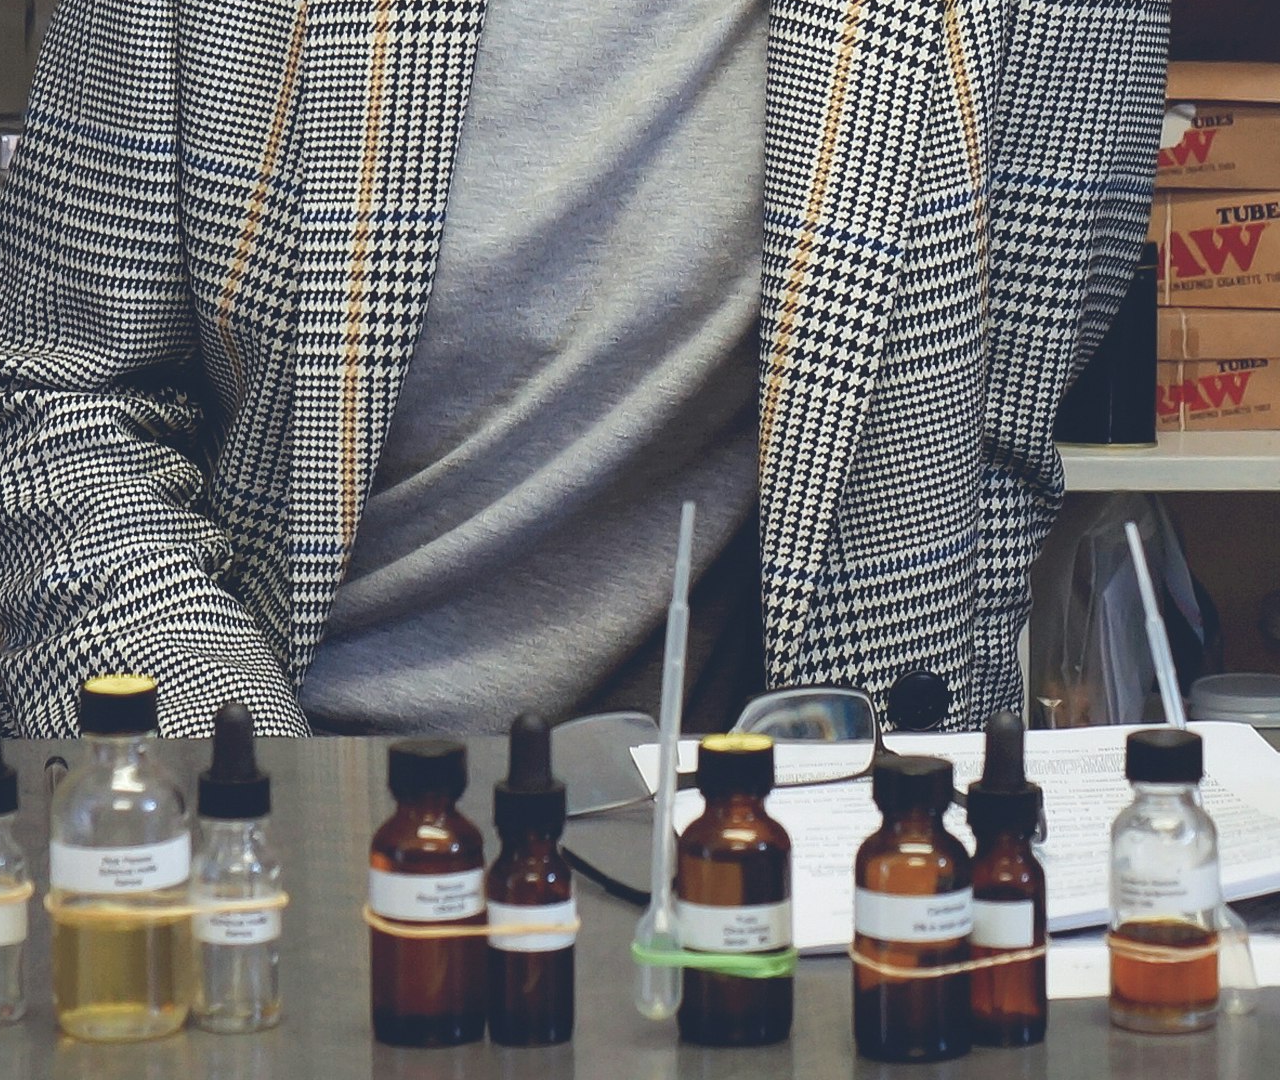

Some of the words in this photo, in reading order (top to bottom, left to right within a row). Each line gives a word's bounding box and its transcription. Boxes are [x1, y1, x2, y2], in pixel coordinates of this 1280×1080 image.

[1190, 112, 1234, 129] UBES
[1157, 222, 1269, 280] AW
[1217, 358, 1268, 373] TUBES
